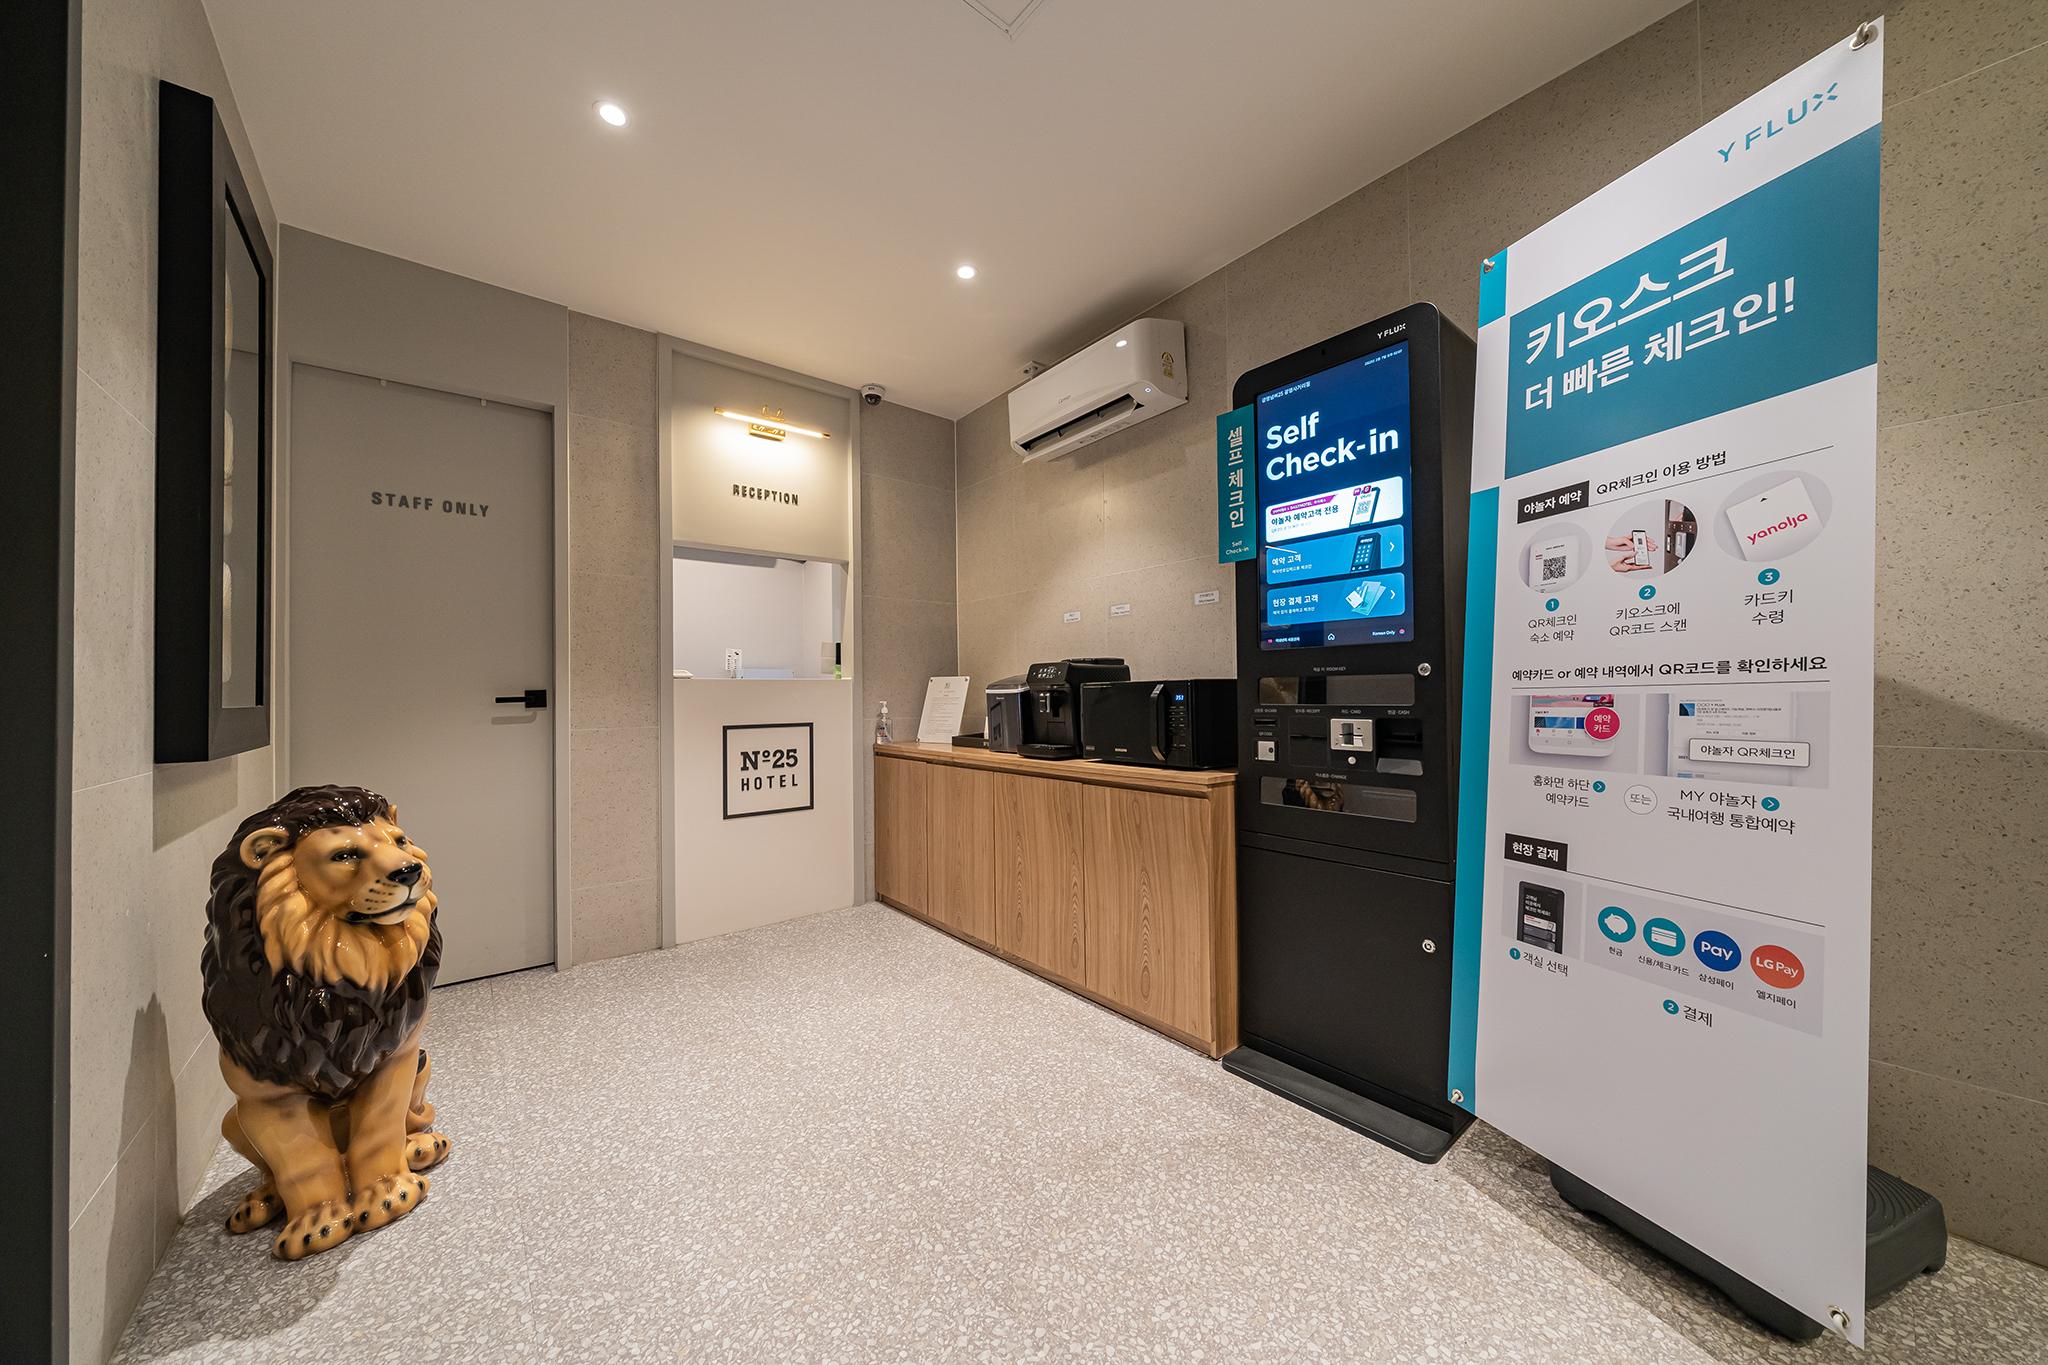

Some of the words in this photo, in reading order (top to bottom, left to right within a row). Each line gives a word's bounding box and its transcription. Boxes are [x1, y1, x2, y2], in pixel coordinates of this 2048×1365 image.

[1717, 142, 1736, 163] Y
[1745, 82, 1838, 151] FLUX
[1526, 237, 1735, 366] 키오스크
[1525, 375, 1552, 411] 더
[1563, 345, 1634, 396] 빠른
[1643, 276, 1796, 365] 체크인!
[1266, 411, 1320, 450] Self
[1266, 428, 1399, 481] Check-in
[1597, 468, 1658, 495] QR체크인
[1662, 461, 1690, 478] 이용
[1696, 450, 1727, 469] 방법
[371, 491, 433, 511] STAFF
[442, 500, 489, 517] ONLY
[733, 484, 799, 506] RECEPTION
[1523, 497, 1557, 515] 야놀자
[1559, 490, 1582, 506] 예약
[1271, 515, 1291, 526] 야놀자
[1293, 508, 1322, 521] 예약고객
[1746, 511, 1808, 545] yanolja
[1271, 556, 1286, 566] 예약
[1287, 553, 1302, 563] 고객
[1272, 597, 1286, 607] 현장
[1288, 595, 1302, 606] 결제
[1303, 594, 1319, 603] 고객
[1744, 589, 1793, 607] 카드키
[1616, 602, 1680, 620] 키오스크에
[1752, 609, 1784, 625] 수령
[1528, 614, 1577, 629] QR체크인
[1610, 622, 1655, 637] QR코드
[1660, 619, 1687, 634] 스캔
[1530, 632, 1549, 643] 숙소
[1553, 629, 1574, 642] 예약
[1512, 669, 1554, 681] 예약카드
[1558, 670, 1571, 679] or
[1574, 666, 1598, 679] 예약
[1602, 664, 1654, 678] 내역에서
[1658, 661, 1732, 676] QR코드를
[1737, 656, 1828, 674] 확인하세요
[1593, 714, 1611, 724] 예약
[1593, 724, 1611, 733] 카드
[1700, 745, 1734, 757] 야놀자
[1737, 747, 1795, 760] QR체크인
[741, 773, 799, 792] HOTEL
[1533, 775, 1564, 790] 홈화면
[1567, 778, 1590, 792] 하단
[1545, 792, 1590, 807] 예약카드
[1629, 792, 1652, 805] 또는
[1680, 789, 1705, 801] MY
[1709, 790, 1757, 809] 야놀자
[1667, 806, 1725, 826] 국내여행
[1729, 814, 1796, 835] 통합예약
[1512, 841, 1534, 857] 현장
[1536, 845, 1559, 862] 결제
[1608, 946, 1623, 957] 현금
[1701, 941, 1733, 961] Pay
[1523, 952, 1543, 968] 객실
[1546, 957, 1569, 977] 선택
[1638, 955, 1689, 976] 신용/체크카드
[1755, 956, 1774, 971] LG
[1775, 960, 1800, 979] Pay
[1699, 973, 1735, 990] 삼성페이
[1756, 990, 1796, 1009] 엘지페이
[1684, 1004, 1713, 1027] 결제
